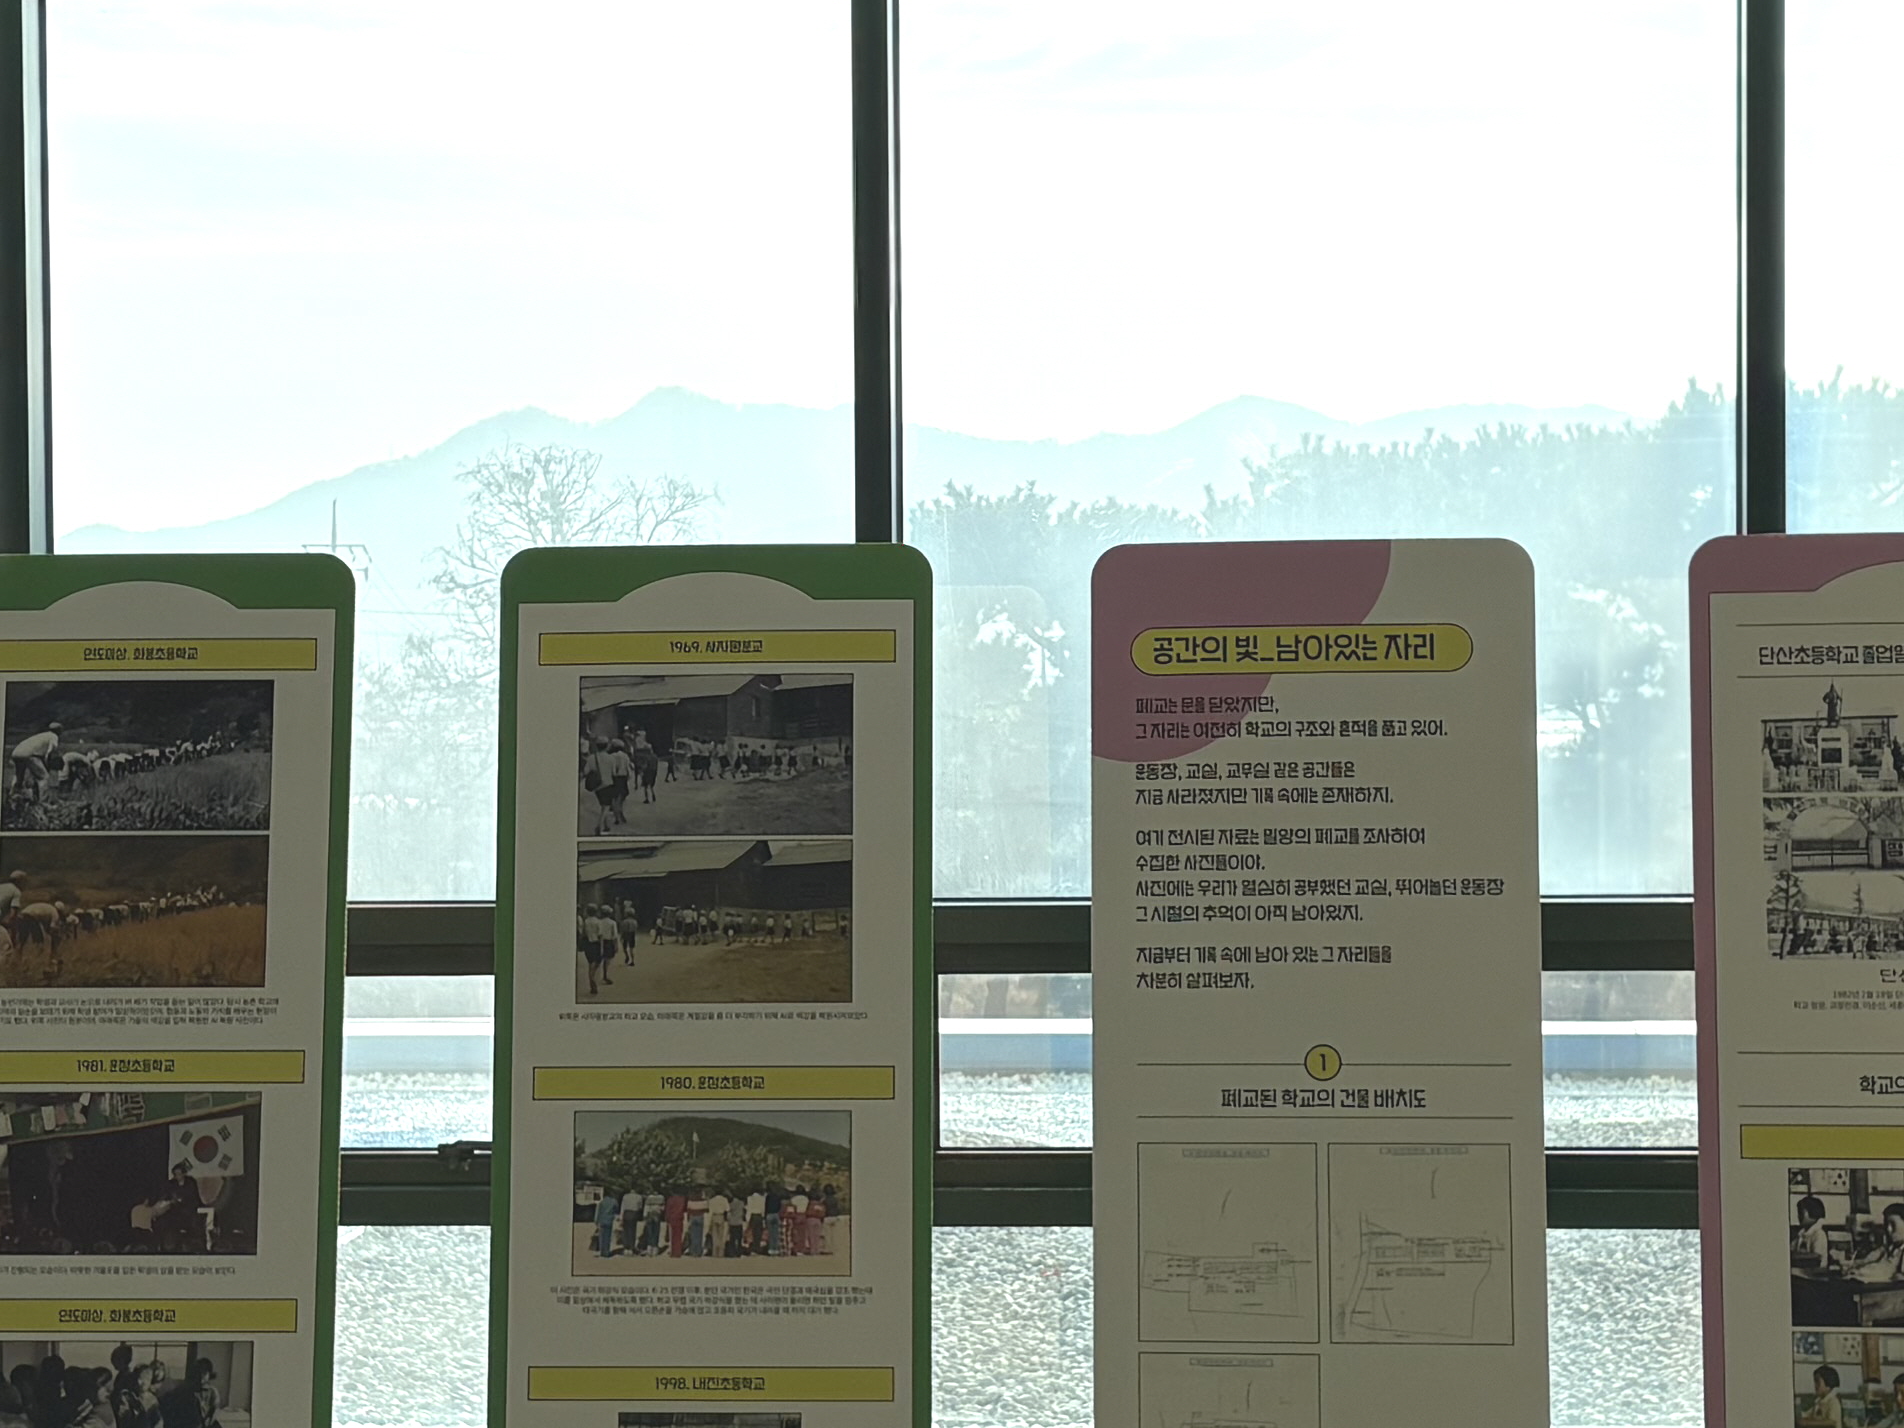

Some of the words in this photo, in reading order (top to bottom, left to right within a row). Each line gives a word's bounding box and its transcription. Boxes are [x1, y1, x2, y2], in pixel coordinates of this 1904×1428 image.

[1153, 636, 1227, 664] 공간의
[1384, 633, 1434, 660] 자리
[1759, 645, 1859, 665] 단산초등학교
[1136, 698, 1178, 714] 폐교는
[1181, 697, 1205, 714] 문을
[1209, 697, 1279, 715] 닫았지만,
[1136, 763, 1182, 781] 운동장,
[1185, 763, 1222, 781] 교실,
[1226, 762, 1270, 779] 교무실
[1273, 762, 1299, 778] 같은
[1302, 761, 1355, 778] 공간들은
[1136, 830, 1163, 846] 여기
[1168, 829, 1214, 846] 전시된
[1218, 829, 1259, 846] 자료는
[1264, 828, 1311, 845] 밀양의
[1315, 828, 1359, 844] 폐교를
[1363, 828, 1425, 844] 조사하여
[1136, 854, 1180, 871] 수집한
[1184, 854, 1265, 871] 사진들이야.
[1137, 972, 1182, 989] 차분히
[1184, 972, 1254, 989] 살펴보자.
[1319, 1053, 1326, 1071] 1
[1221, 1089, 1277, 1108] 폐교된
[1282, 1089, 1334, 1108] 학교의
[1340, 1089, 1369, 1108] 건물
[1374, 1089, 1426, 1108] 배치도
